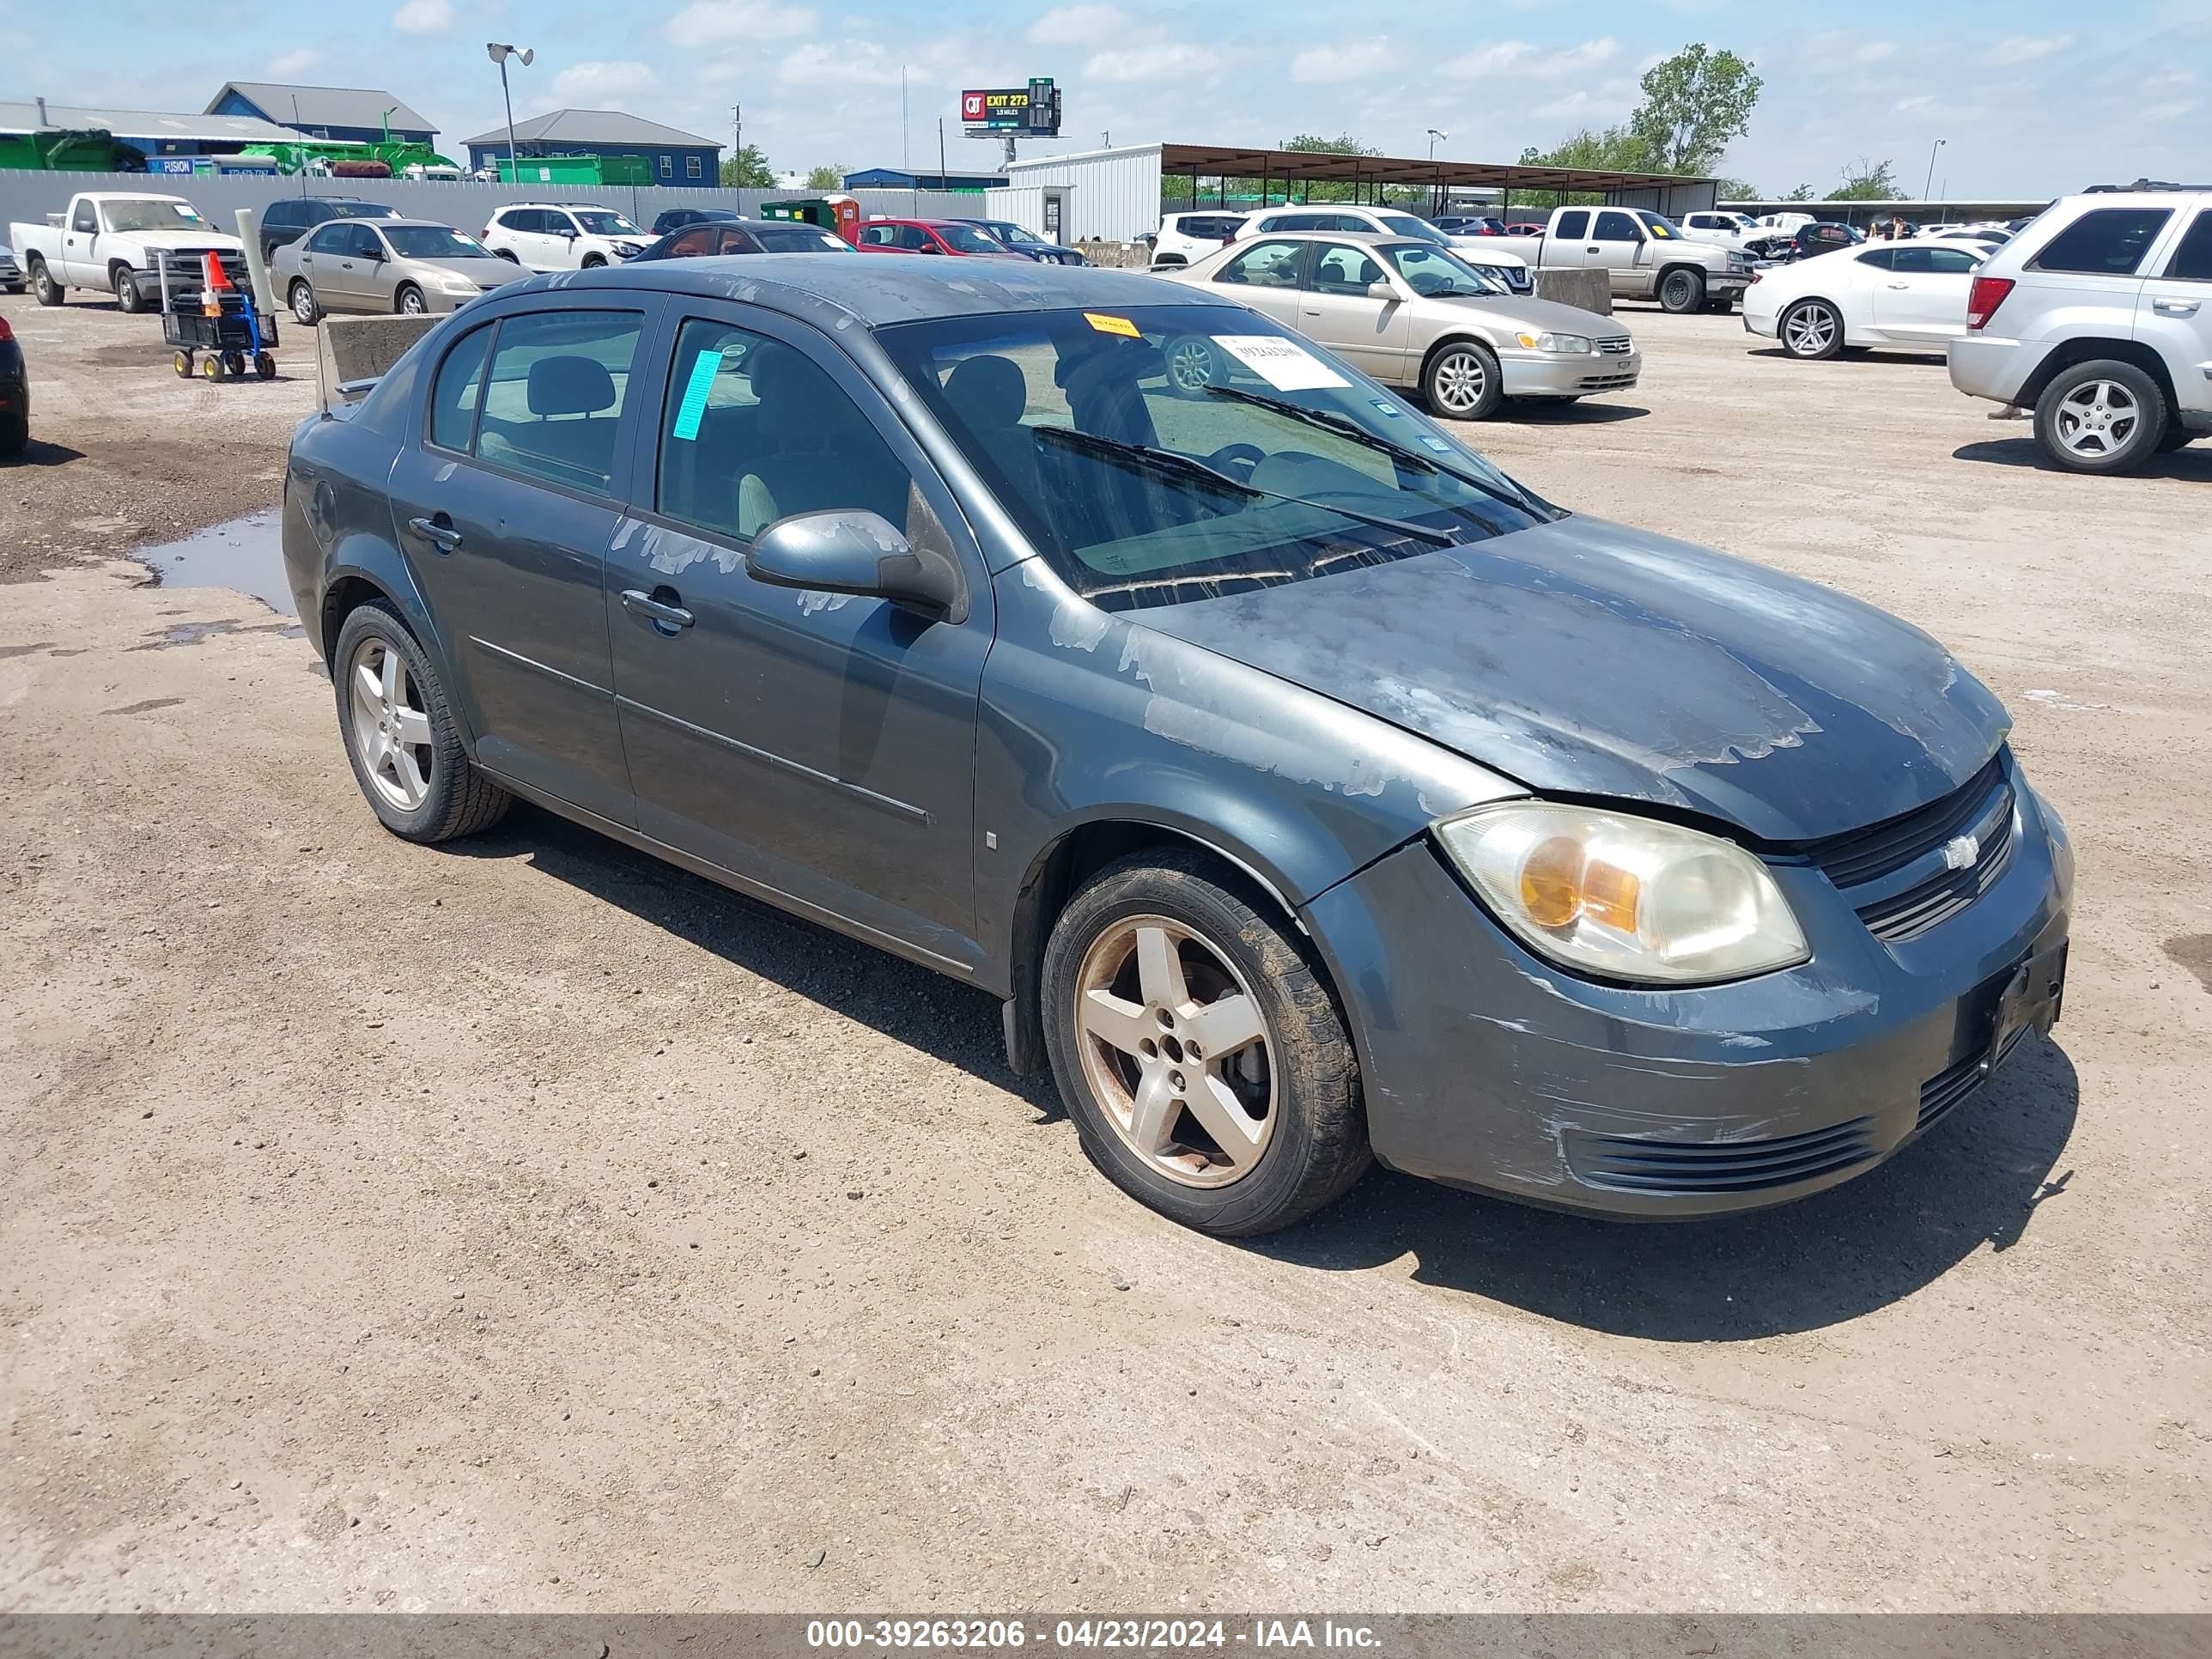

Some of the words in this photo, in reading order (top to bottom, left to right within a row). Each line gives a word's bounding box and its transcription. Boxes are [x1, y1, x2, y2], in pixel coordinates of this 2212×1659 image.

[966, 97, 981, 114] QT
[987, 96, 1008, 106] EXIT
[1010, 95, 1028, 106] 273
[164, 161, 191, 173] FUSION
